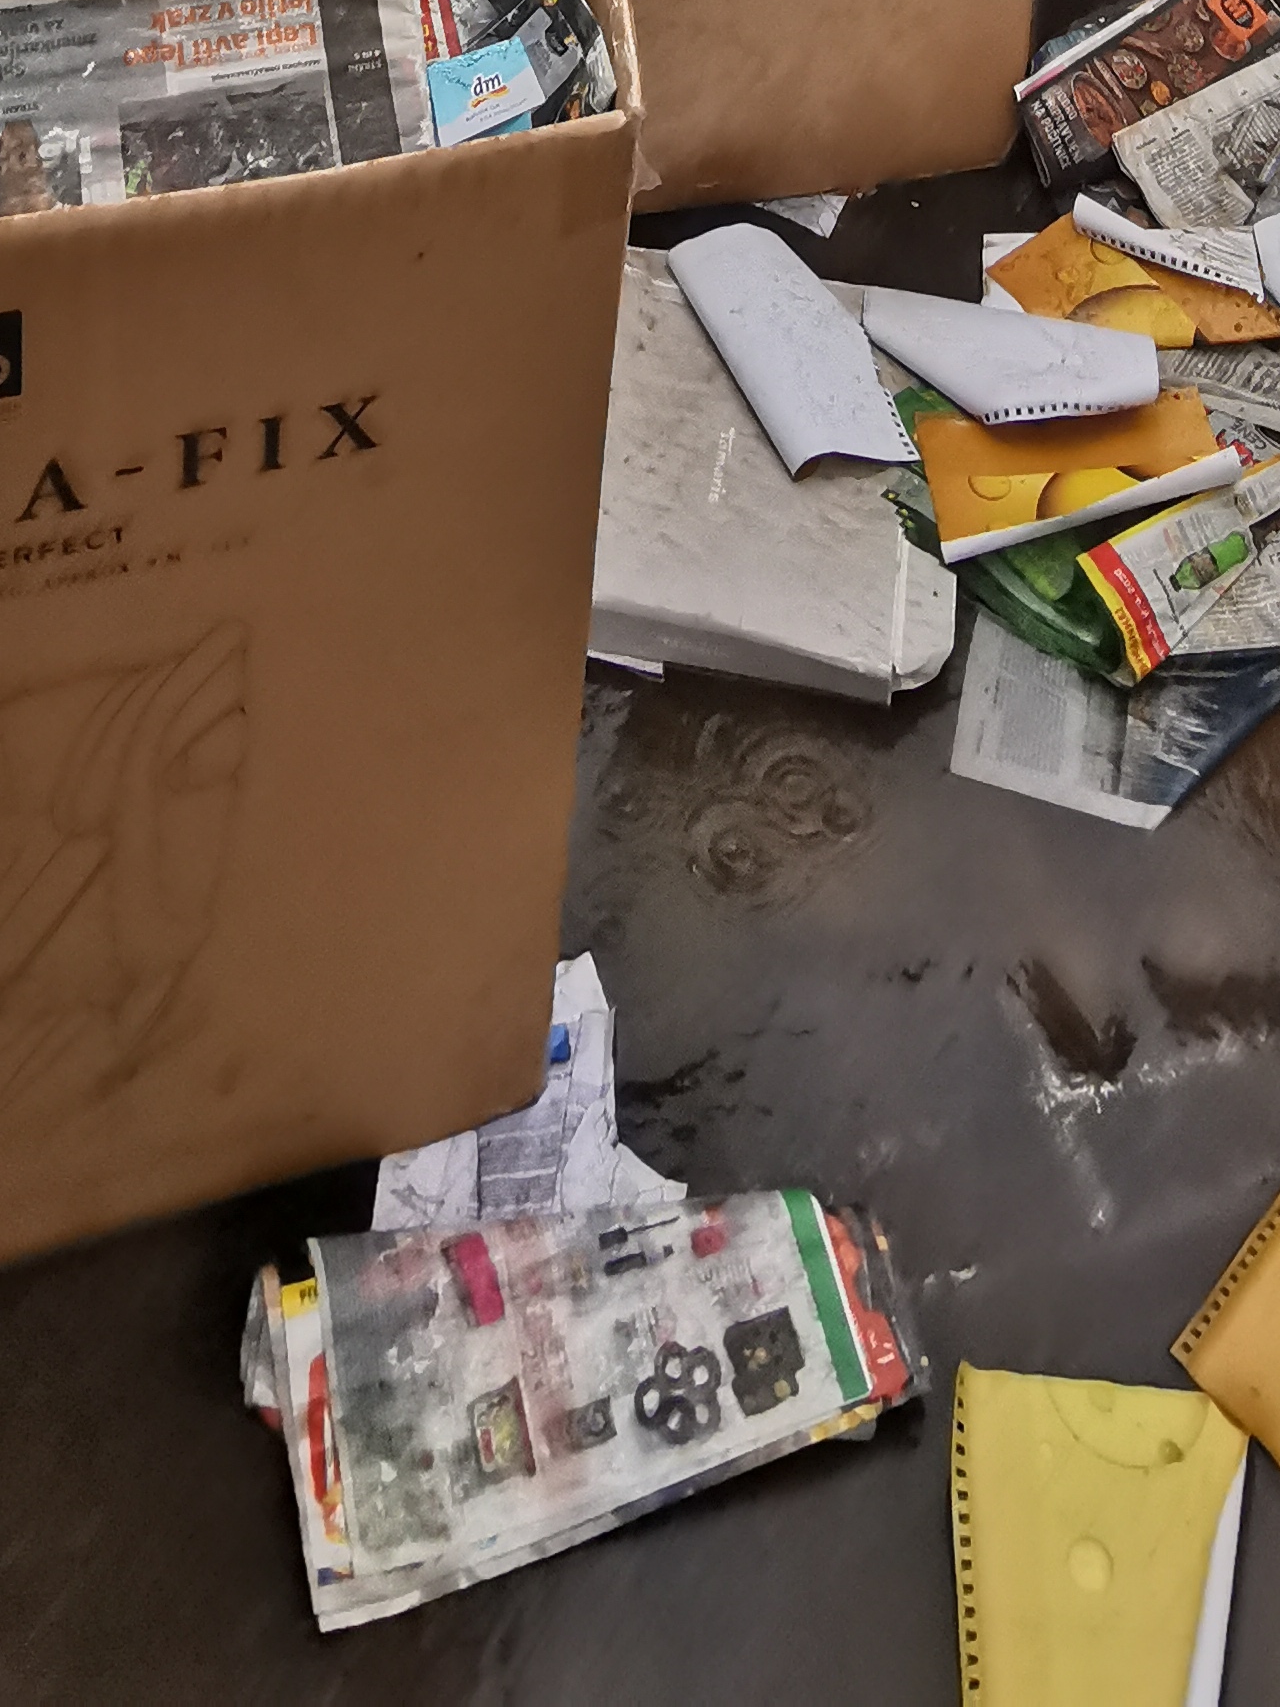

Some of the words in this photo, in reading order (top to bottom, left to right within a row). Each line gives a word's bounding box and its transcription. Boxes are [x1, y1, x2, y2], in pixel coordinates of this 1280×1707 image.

[149, 4, 212, 34] zrak
[217, 2, 234, 20] v
[256, 22, 318, 48] Lepi
[122, 40, 185, 69] lepo
[472, 73, 502, 96] dm
[707, 426, 736, 504] Tamaris
